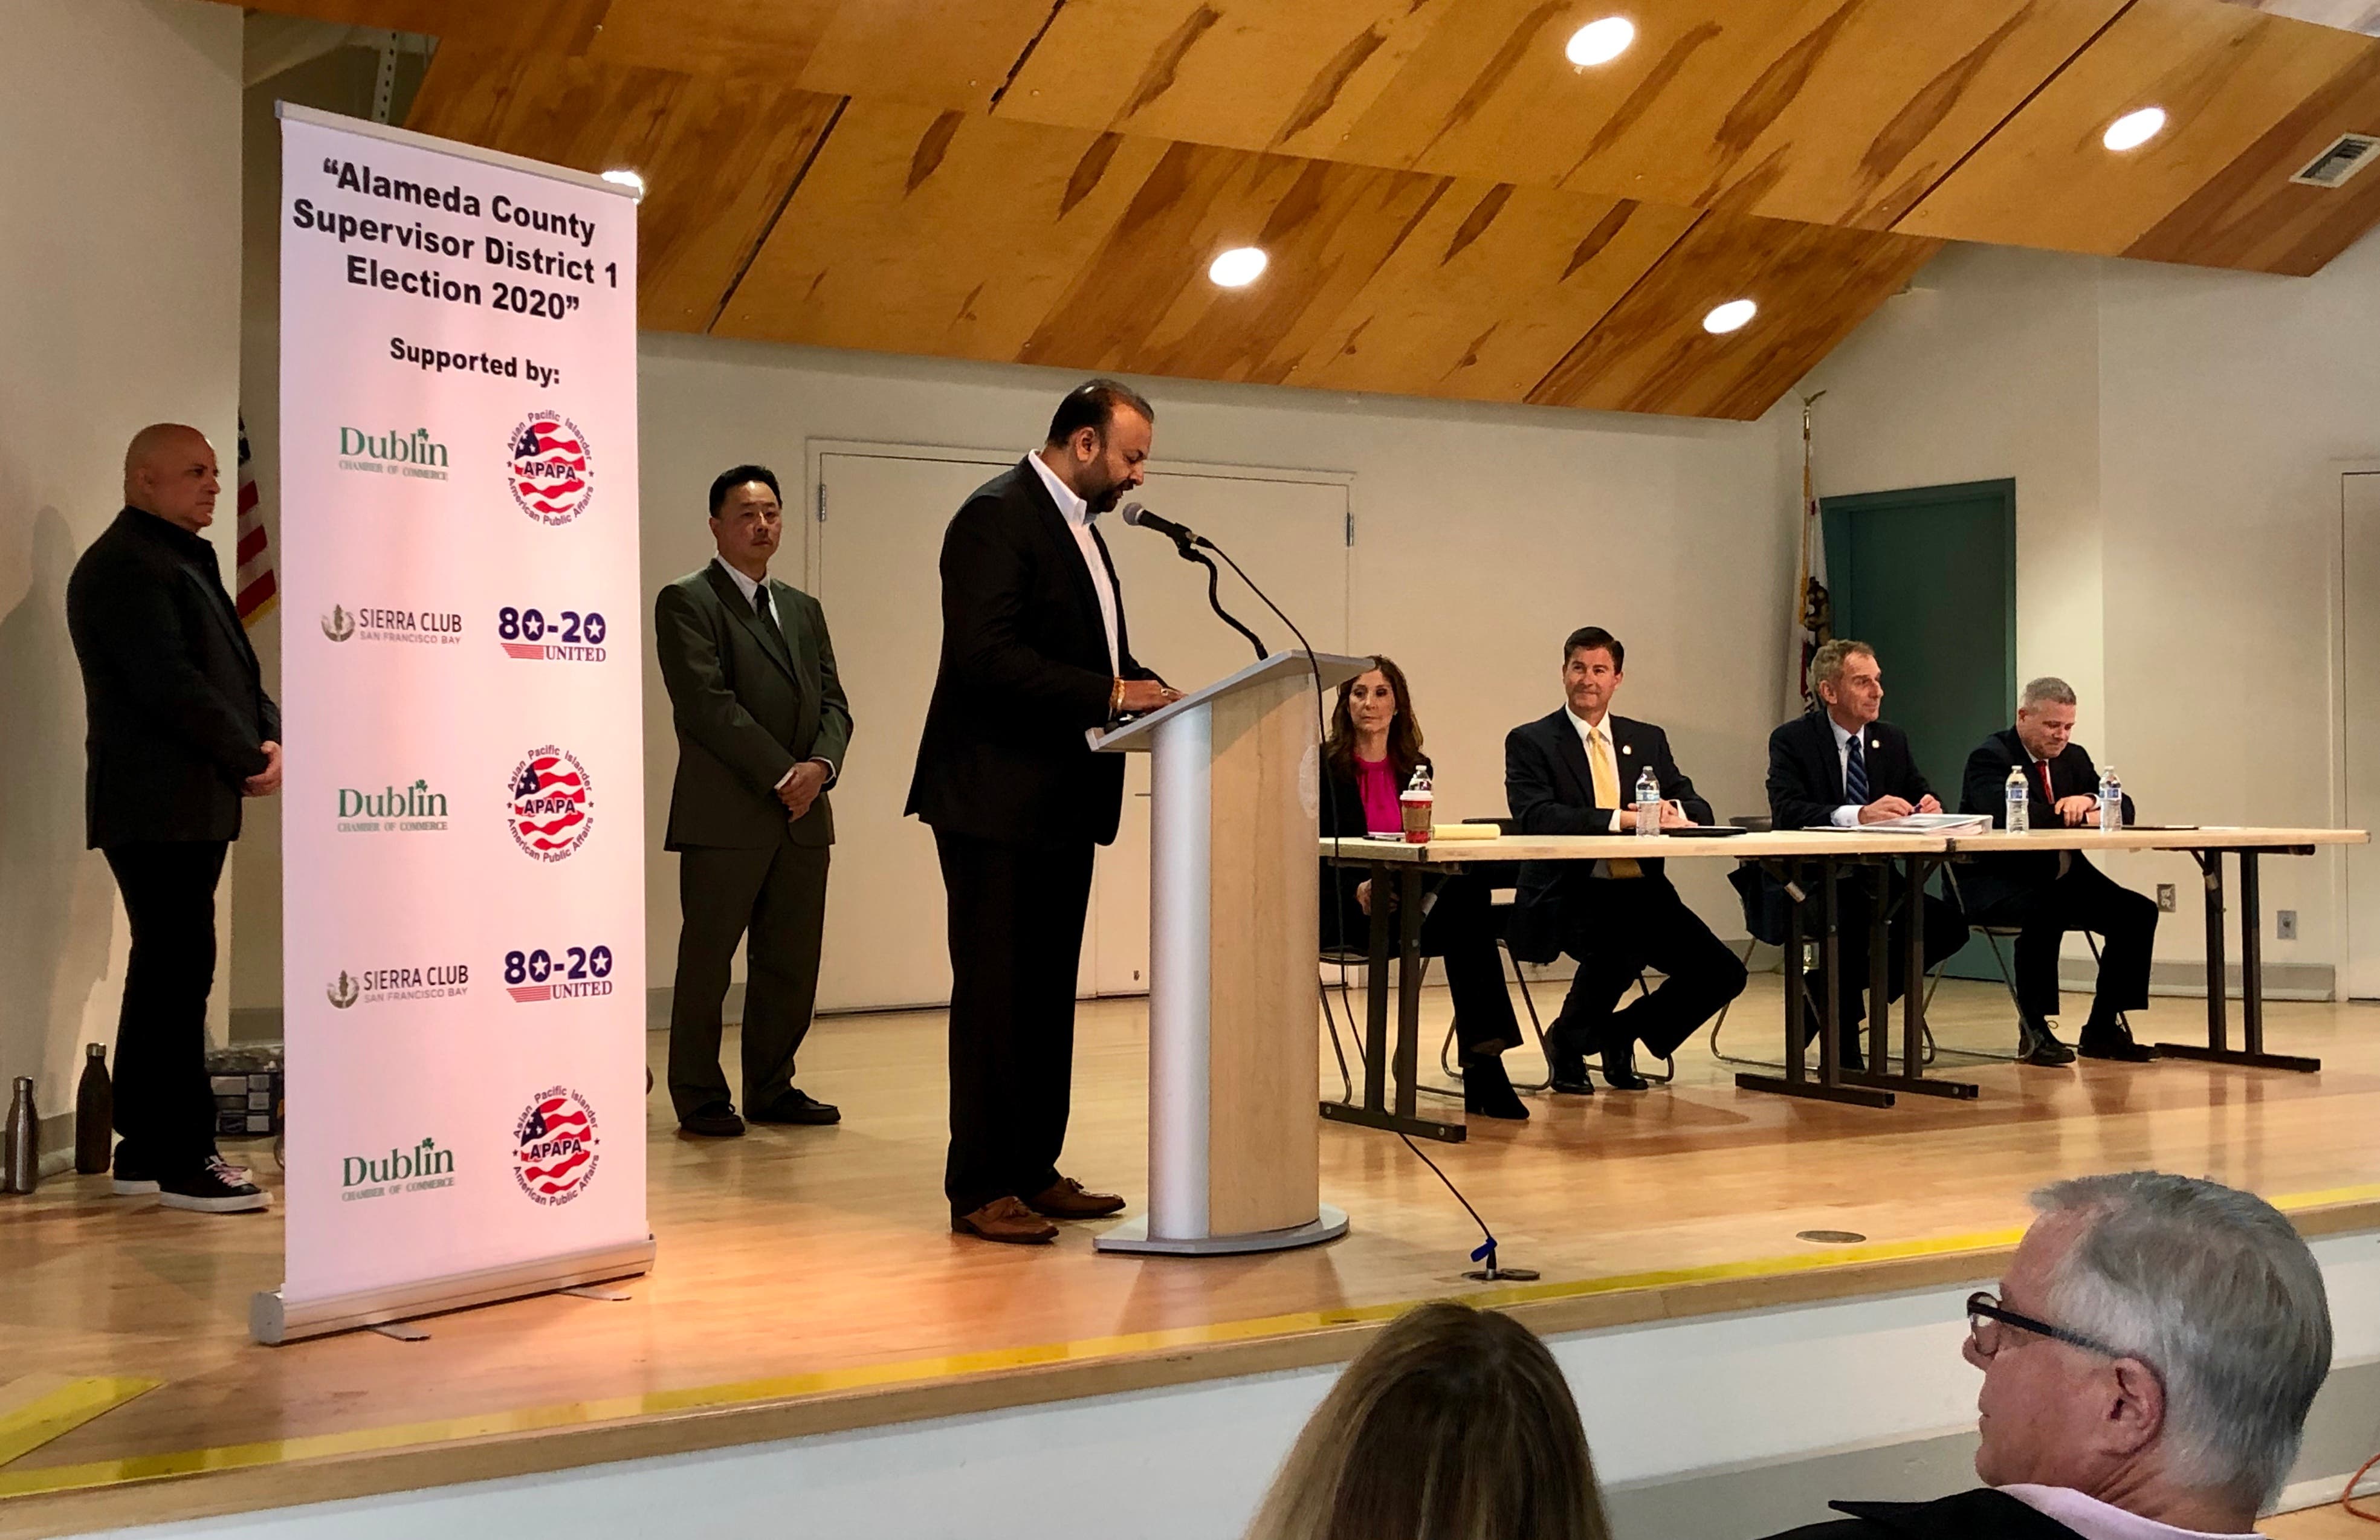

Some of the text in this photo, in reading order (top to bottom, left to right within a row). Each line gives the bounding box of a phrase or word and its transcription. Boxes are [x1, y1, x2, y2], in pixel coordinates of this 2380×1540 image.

[323, 158, 595, 247] “Alameda County
[293, 199, 616, 288] Supervisor District 1
[348, 254, 579, 320] Election 2020”
[390, 337, 560, 388] Supported by:
[340, 427, 448, 467] Dublin
[507, 410, 592, 461] Asian Pacific Islander
[339, 460, 448, 481] CHAMBER OF COMMERCE
[524, 461, 576, 479] APAPA
[508, 477, 593, 526] American Public Affairs
[360, 608, 462, 632] SIERRA CLUB
[360, 631, 461, 644] SAN FRANCISCO BAY
[499, 607, 606, 644] 80-20
[546, 645, 606, 662] UNITED
[508, 745, 592, 792] Asian Pacific Islander
[338, 779, 448, 818] Dublin
[524, 800, 576, 814] APAPA
[338, 821, 448, 832] CHAMBER OF COMMERCE
[508, 817, 593, 862] American Public Affairs
[364, 965, 468, 991] SIERRA CLUB
[504, 945, 612, 984] 80-20
[364, 987, 468, 1003] SAN FRANCISCO BAY
[552, 981, 612, 1000] UNITED
[513, 1085, 598, 1139] Asian Pacific Islander
[343, 1137, 454, 1187] Dublin
[530, 1139, 582, 1159] APAPA
[341, 1177, 454, 1202] CHAMBER OF COMMERCE
[513, 1155, 599, 1206] American Public Affairs
